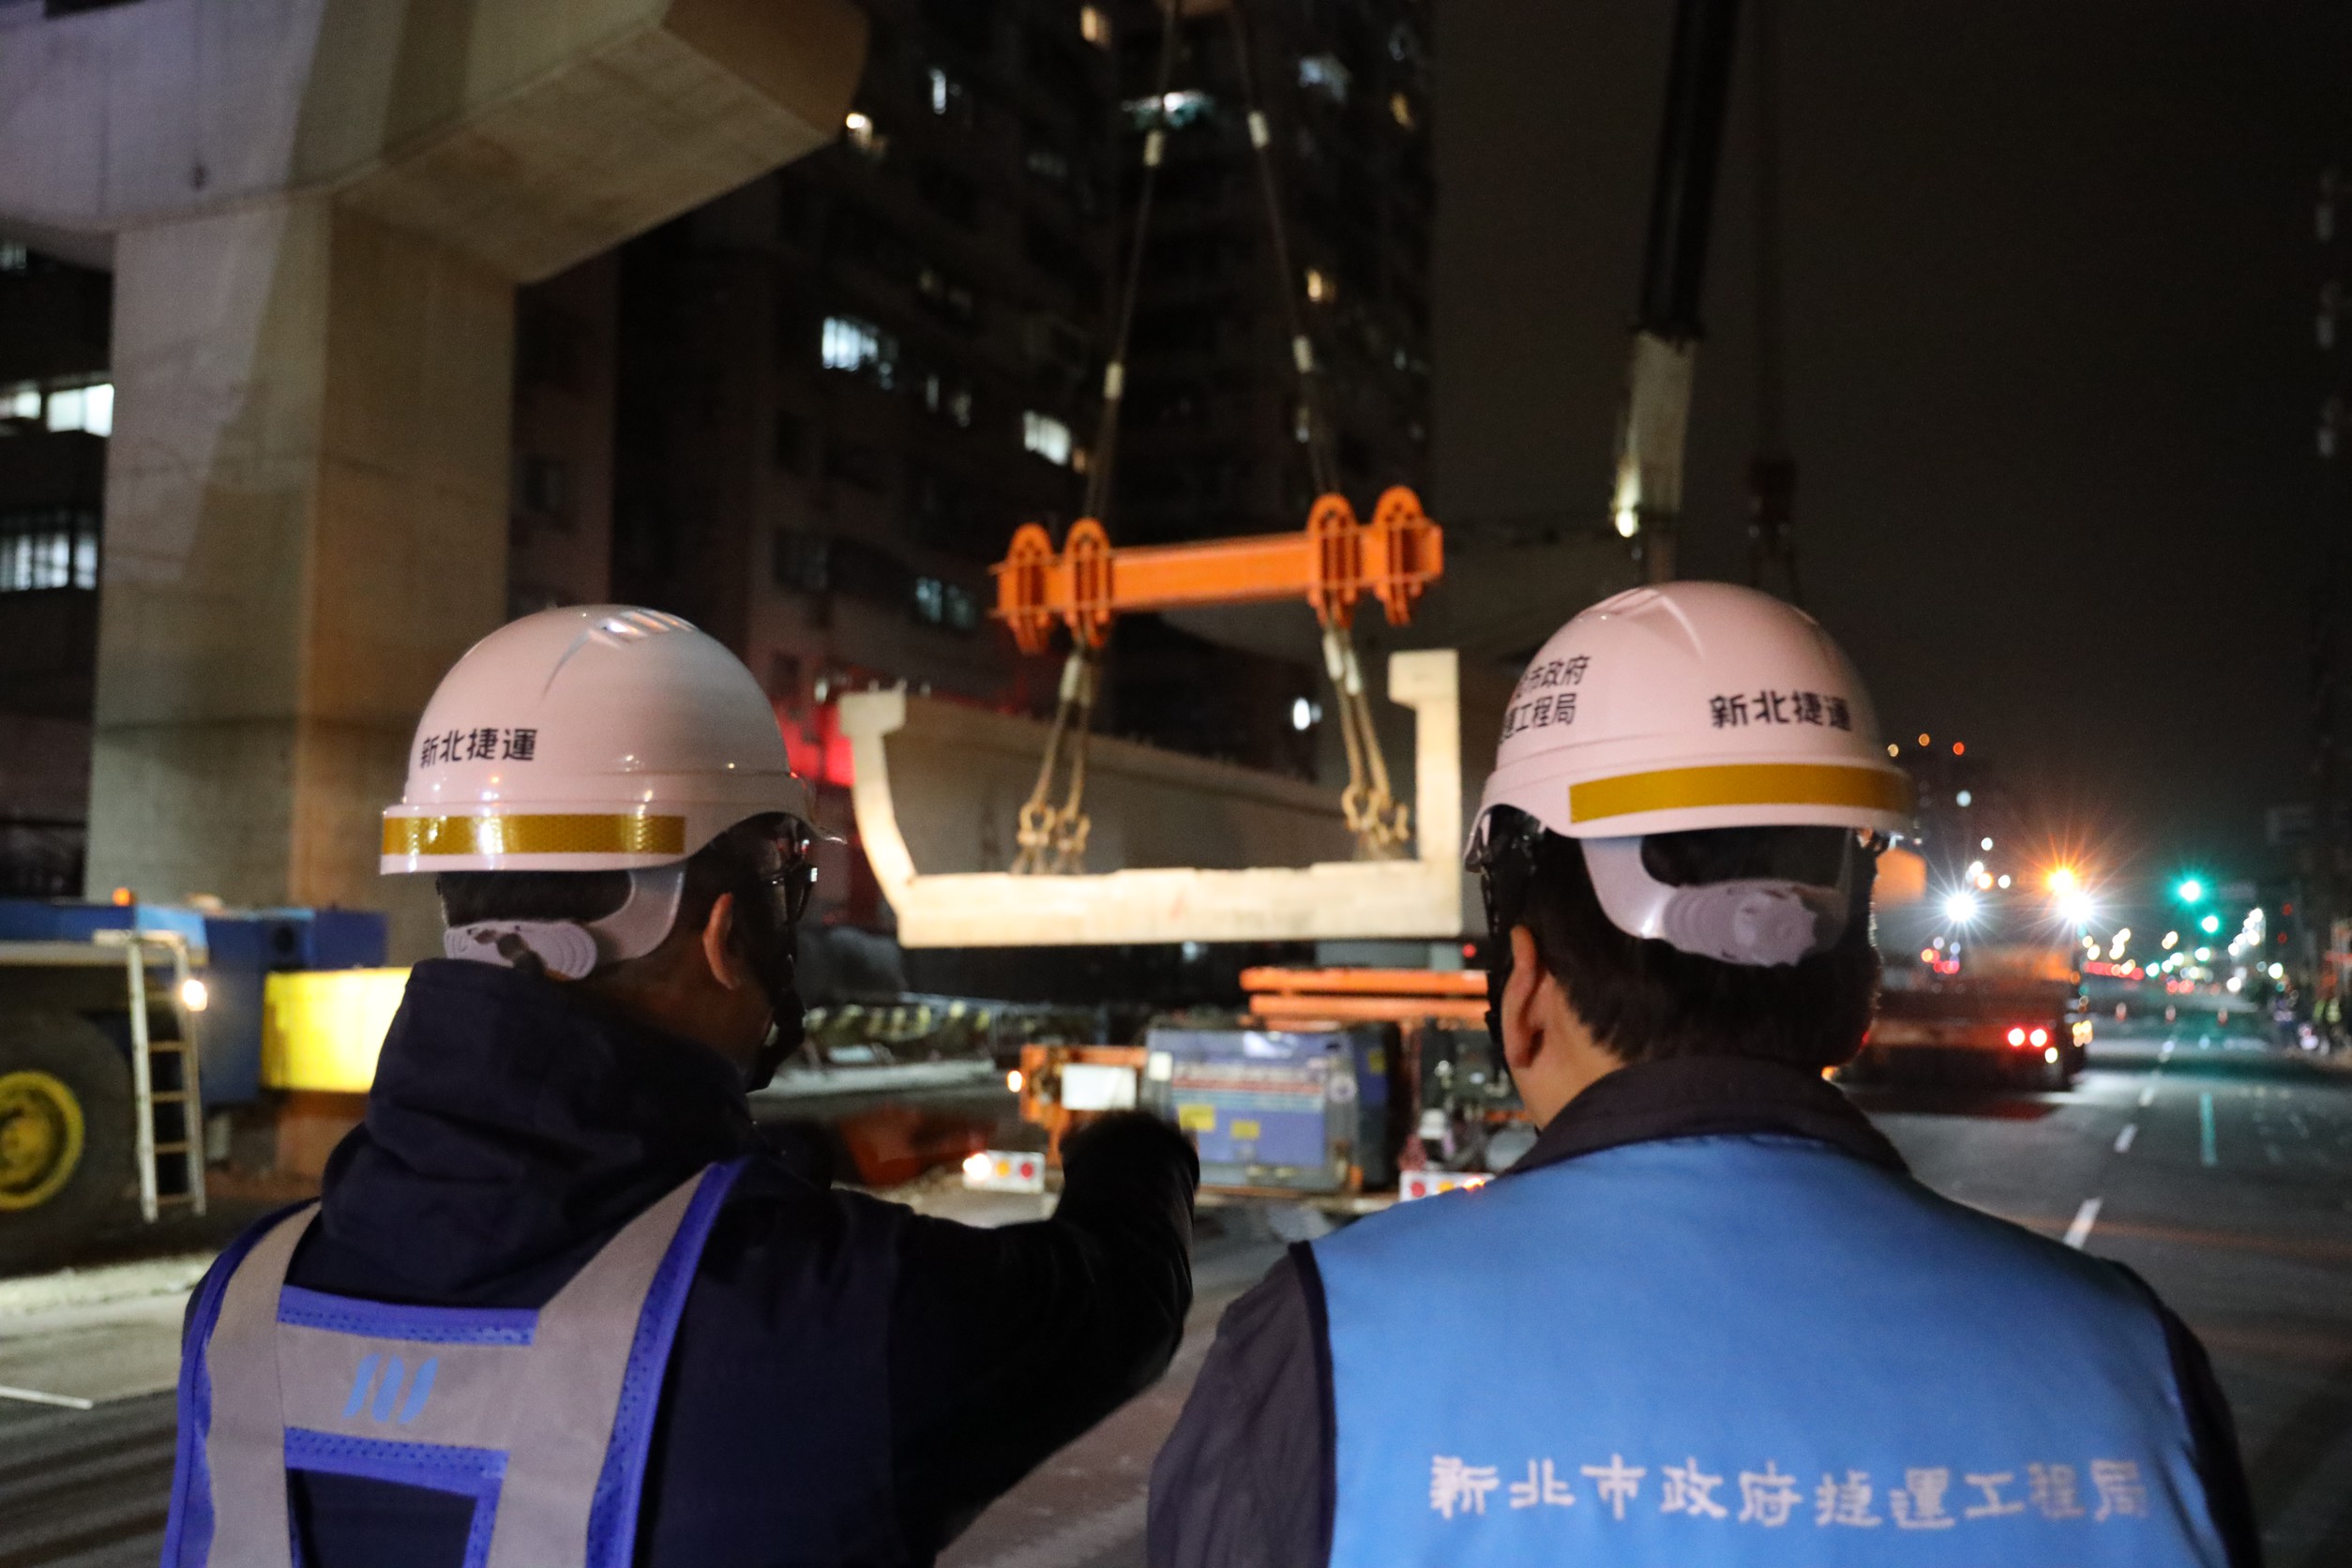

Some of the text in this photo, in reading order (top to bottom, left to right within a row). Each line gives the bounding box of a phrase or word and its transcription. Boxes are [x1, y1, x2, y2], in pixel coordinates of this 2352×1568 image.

[1709, 689, 1852, 732] 新北捷運
[420, 727, 537, 769] 新北捷運
[1430, 1453, 2148, 1530] 新北市政府捷運工程局
